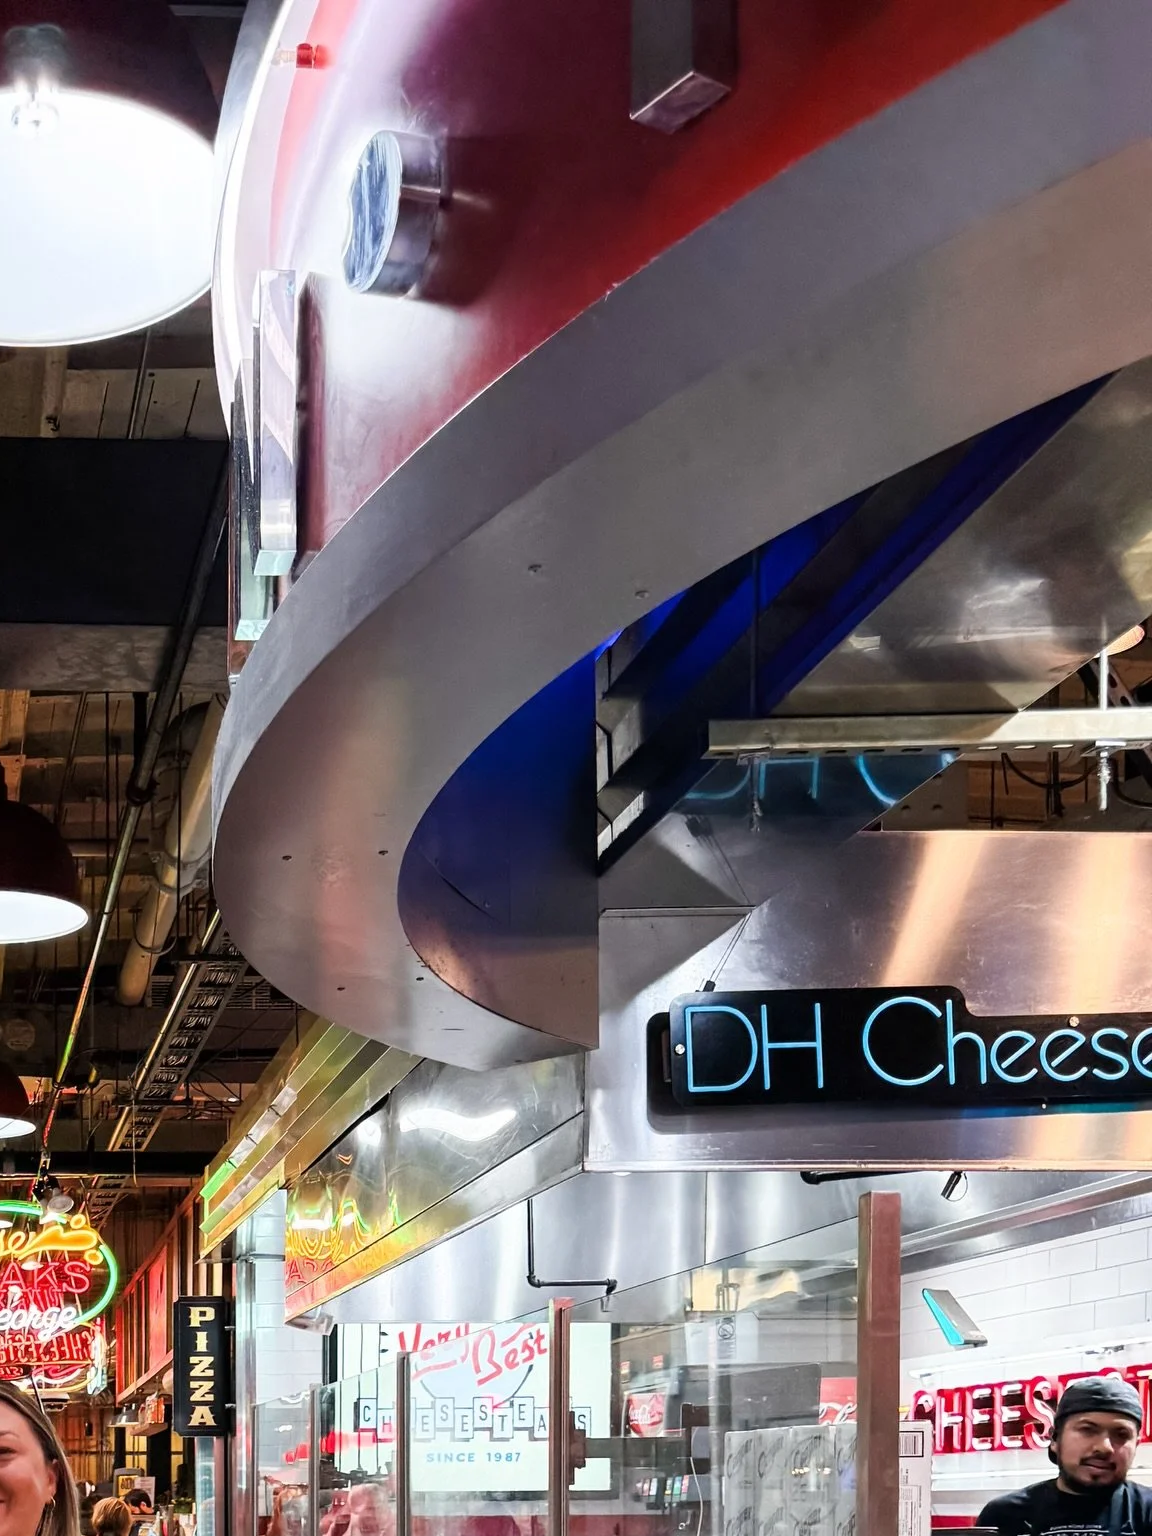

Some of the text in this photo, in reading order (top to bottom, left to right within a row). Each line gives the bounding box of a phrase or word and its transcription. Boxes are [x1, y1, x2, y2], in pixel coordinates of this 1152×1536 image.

[684, 1002, 825, 1093] DH
[187, 1306, 217, 1428] PIZZA
[471, 1326, 548, 1387] Best
[362, 1405, 587, 1434] CHESESTEAS
[426, 1452, 522, 1463] SINCE 1987
